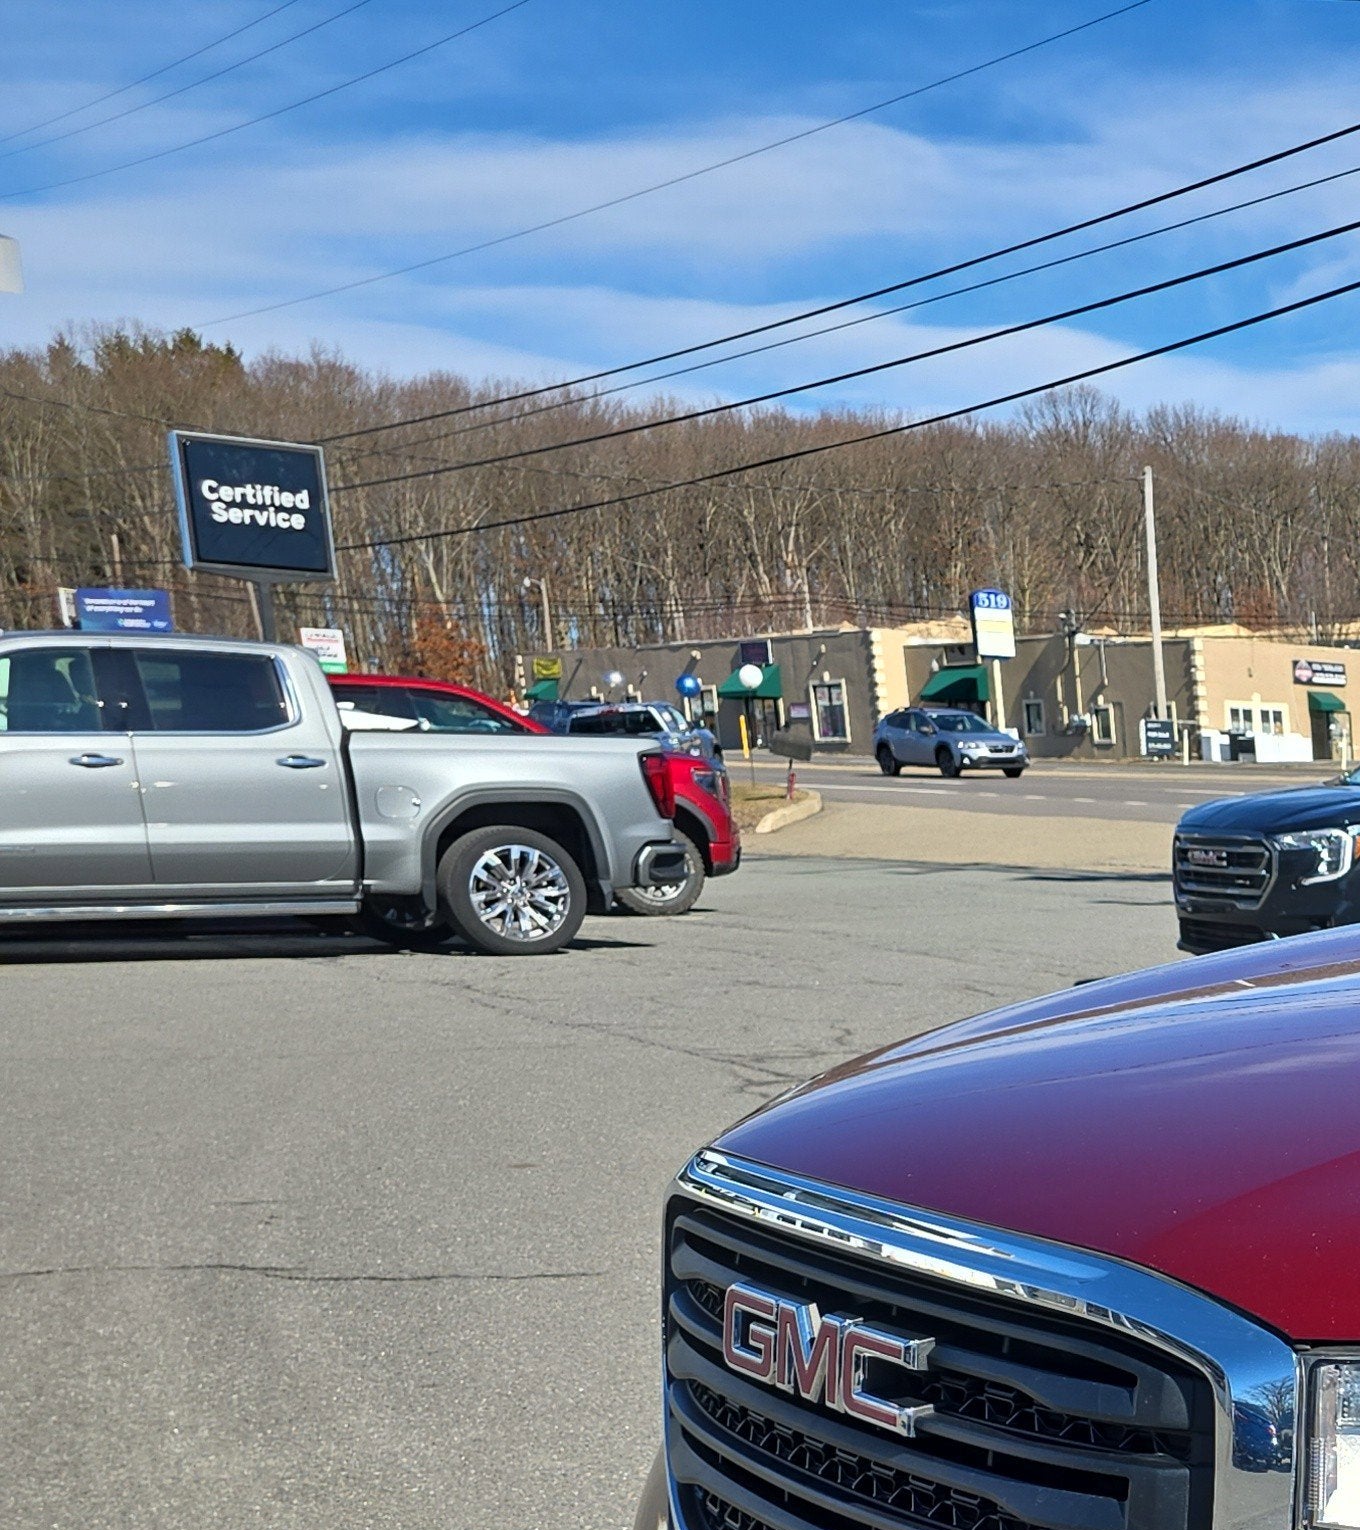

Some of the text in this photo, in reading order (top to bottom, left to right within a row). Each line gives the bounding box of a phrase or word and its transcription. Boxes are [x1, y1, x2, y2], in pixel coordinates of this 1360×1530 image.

[201, 479, 310, 509] Certified
[210, 501, 306, 530] Service
[978, 592, 1007, 608] 519
[1187, 850, 1227, 866] GMC
[723, 1281, 935, 1438] GMC
